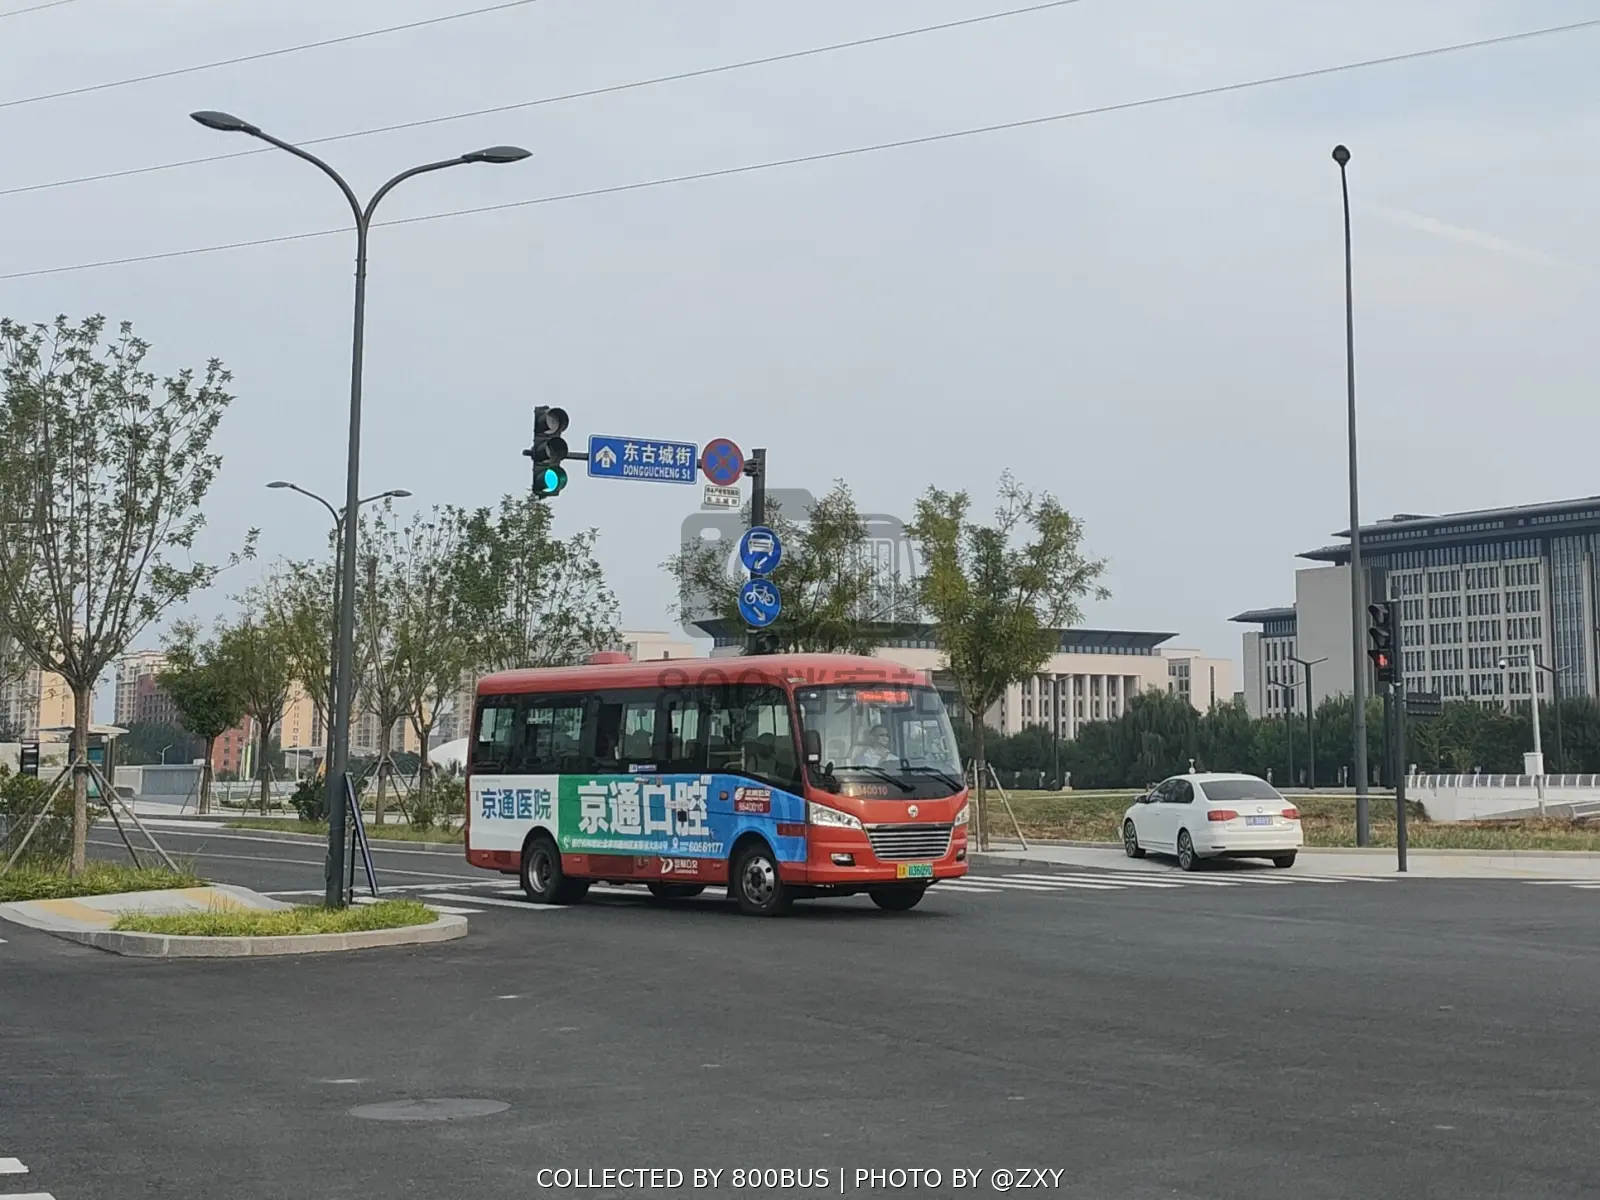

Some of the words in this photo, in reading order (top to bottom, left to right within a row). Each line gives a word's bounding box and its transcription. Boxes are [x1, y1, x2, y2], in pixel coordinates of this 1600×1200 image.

[623, 442, 691, 466] 东古城街
[623, 464, 680, 478] DONGGUCHENG
[681, 470, 691, 480] St
[480, 788, 552, 820] 京通医院
[577, 781, 710, 837] 京通口腔
